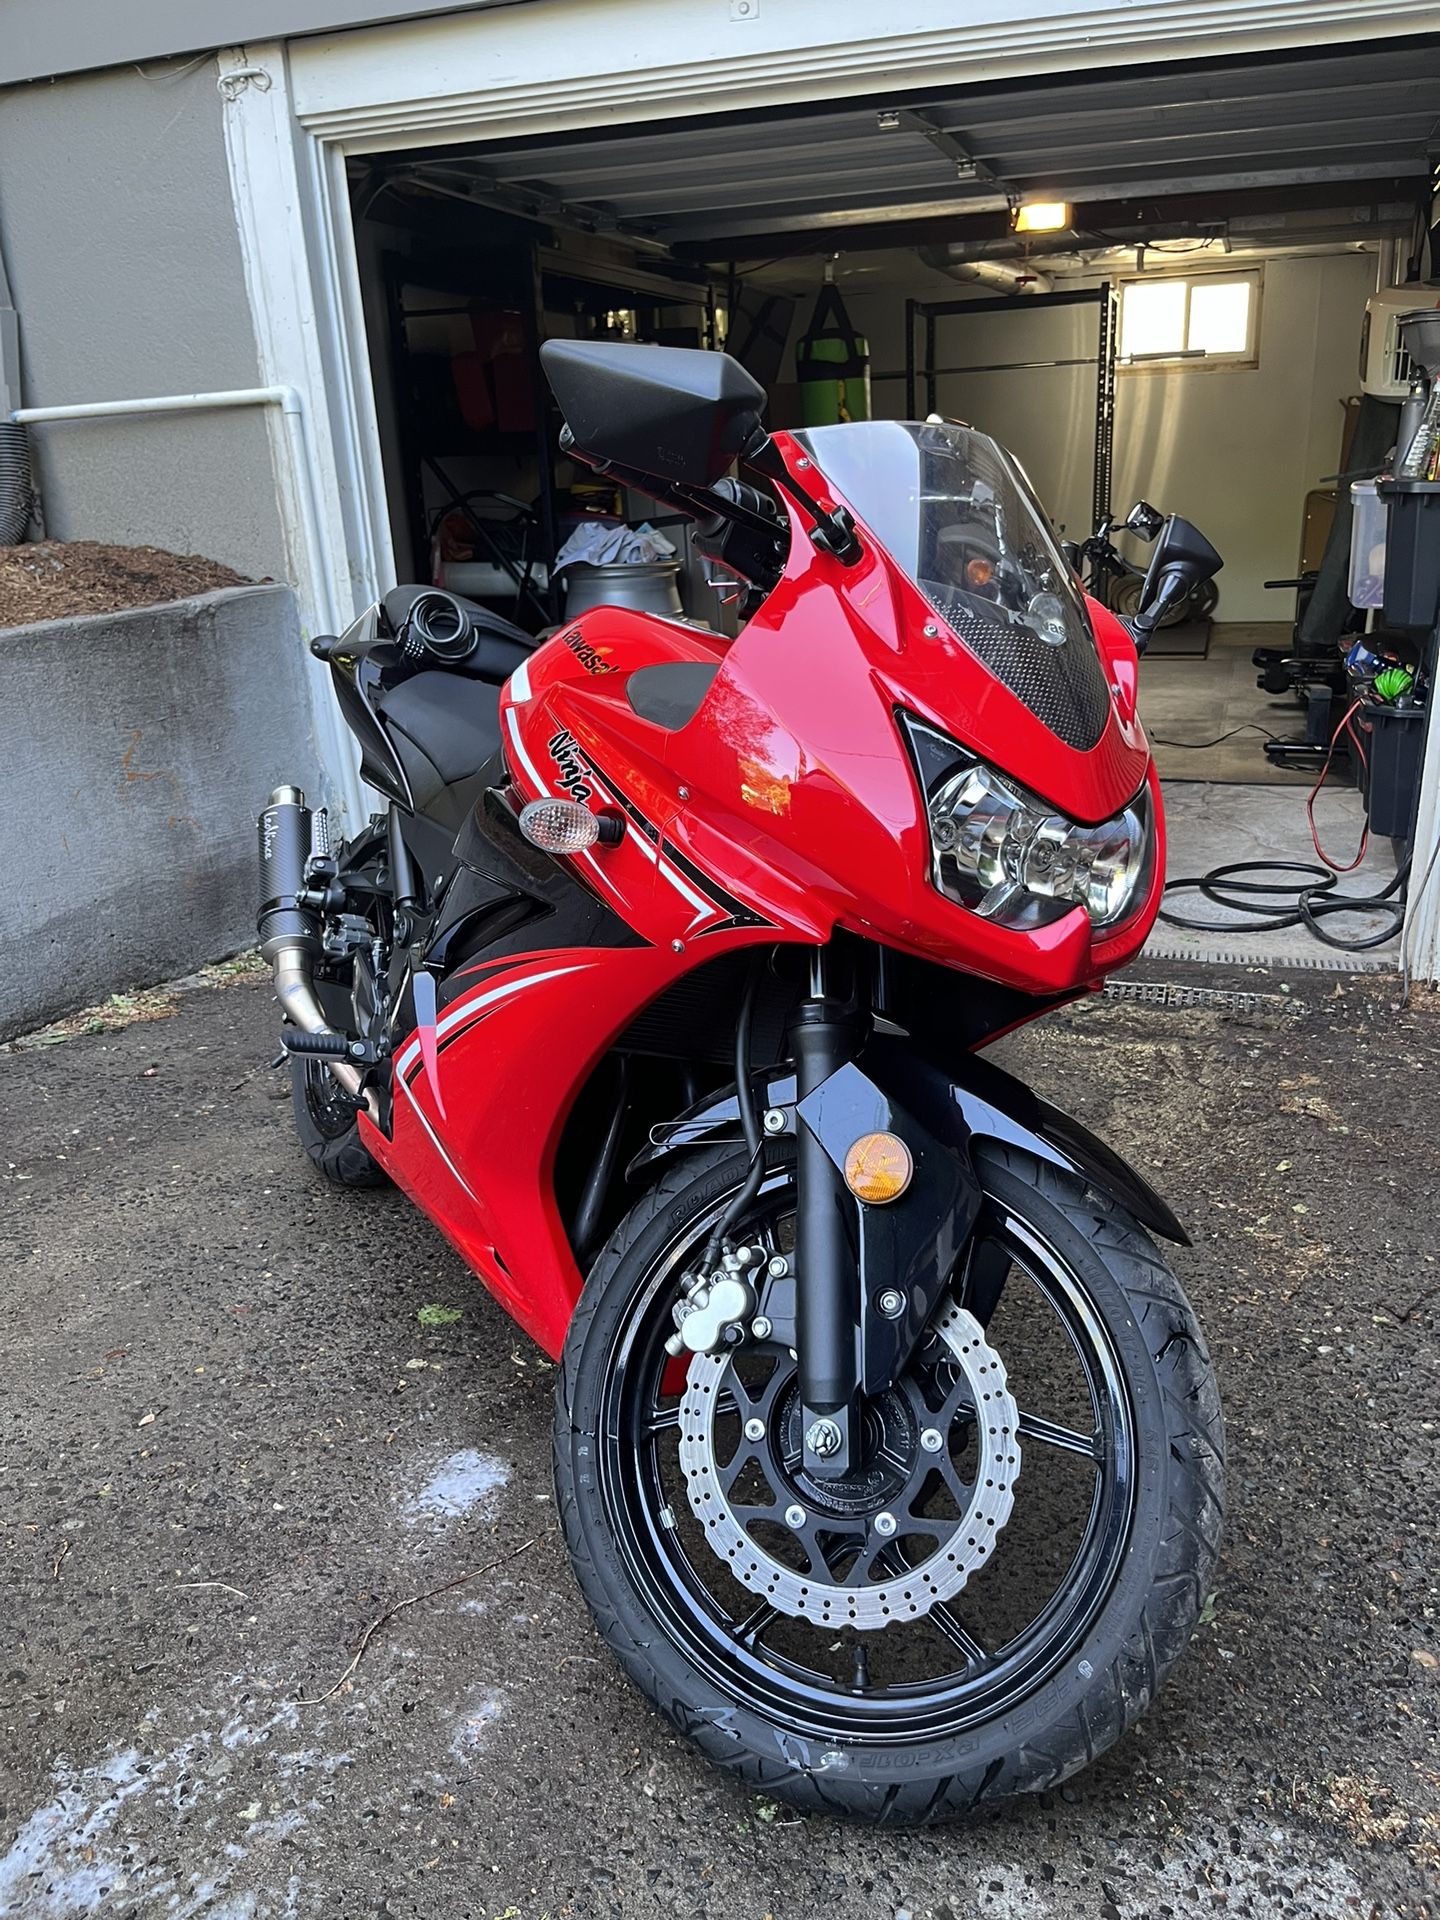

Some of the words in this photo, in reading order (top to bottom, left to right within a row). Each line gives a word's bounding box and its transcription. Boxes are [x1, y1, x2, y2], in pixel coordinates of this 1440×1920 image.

[549, 730, 594, 808] Ninja
[263, 811, 279, 861] LeoVince
[670, 1166, 740, 1224] ROAD
